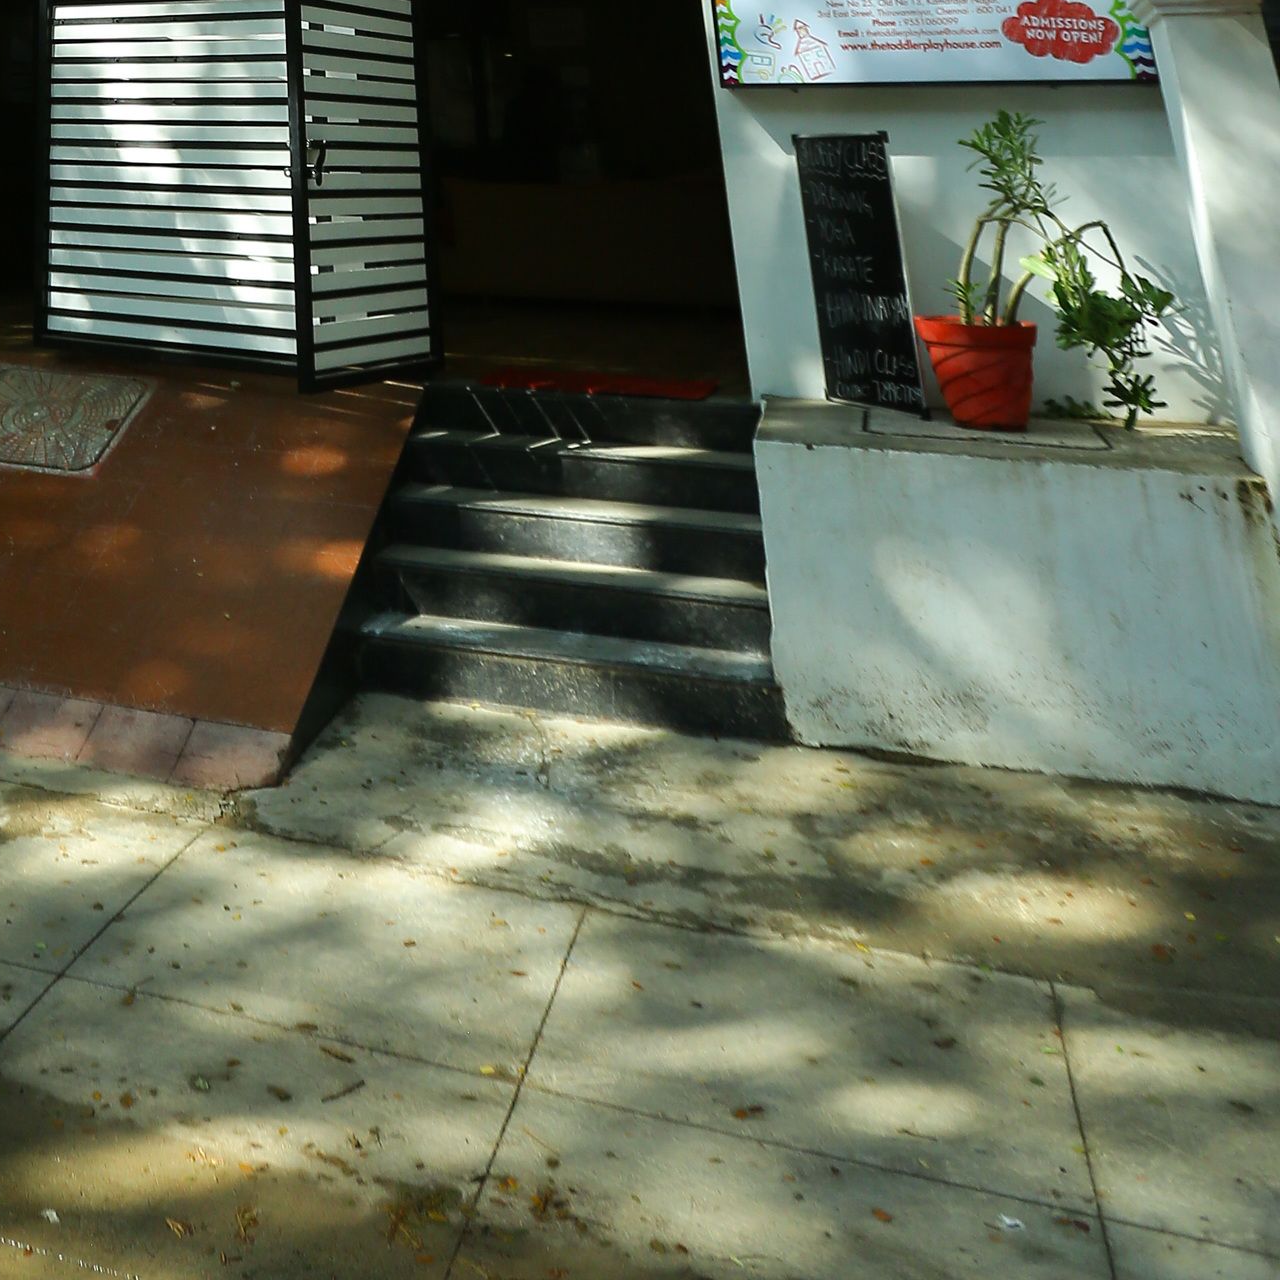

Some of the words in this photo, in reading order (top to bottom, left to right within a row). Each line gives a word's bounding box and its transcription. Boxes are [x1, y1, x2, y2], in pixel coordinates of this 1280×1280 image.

[825, 0, 844, 8] New
[832, 9, 850, 18] East
[975, 6, 993, 15] 600
[872, 18, 896, 27] Phone
[1021, 15, 1106, 32] ADMISSIONS
[838, 29, 859, 38] Email
[1025, 28, 1057, 41] NOW
[1061, 30, 1103, 44] OPEN!
[840, 40, 1002, 53] www.thetoddlerplayhouse.com
[844, 141, 888, 173] CLASS
[810, 180, 874, 218] DRAWING
[817, 216, 855, 245] YOGA
[822, 254, 874, 284] KARATE
[832, 347, 870, 380] HINDI
[873, 349, 917, 379] CLASS
